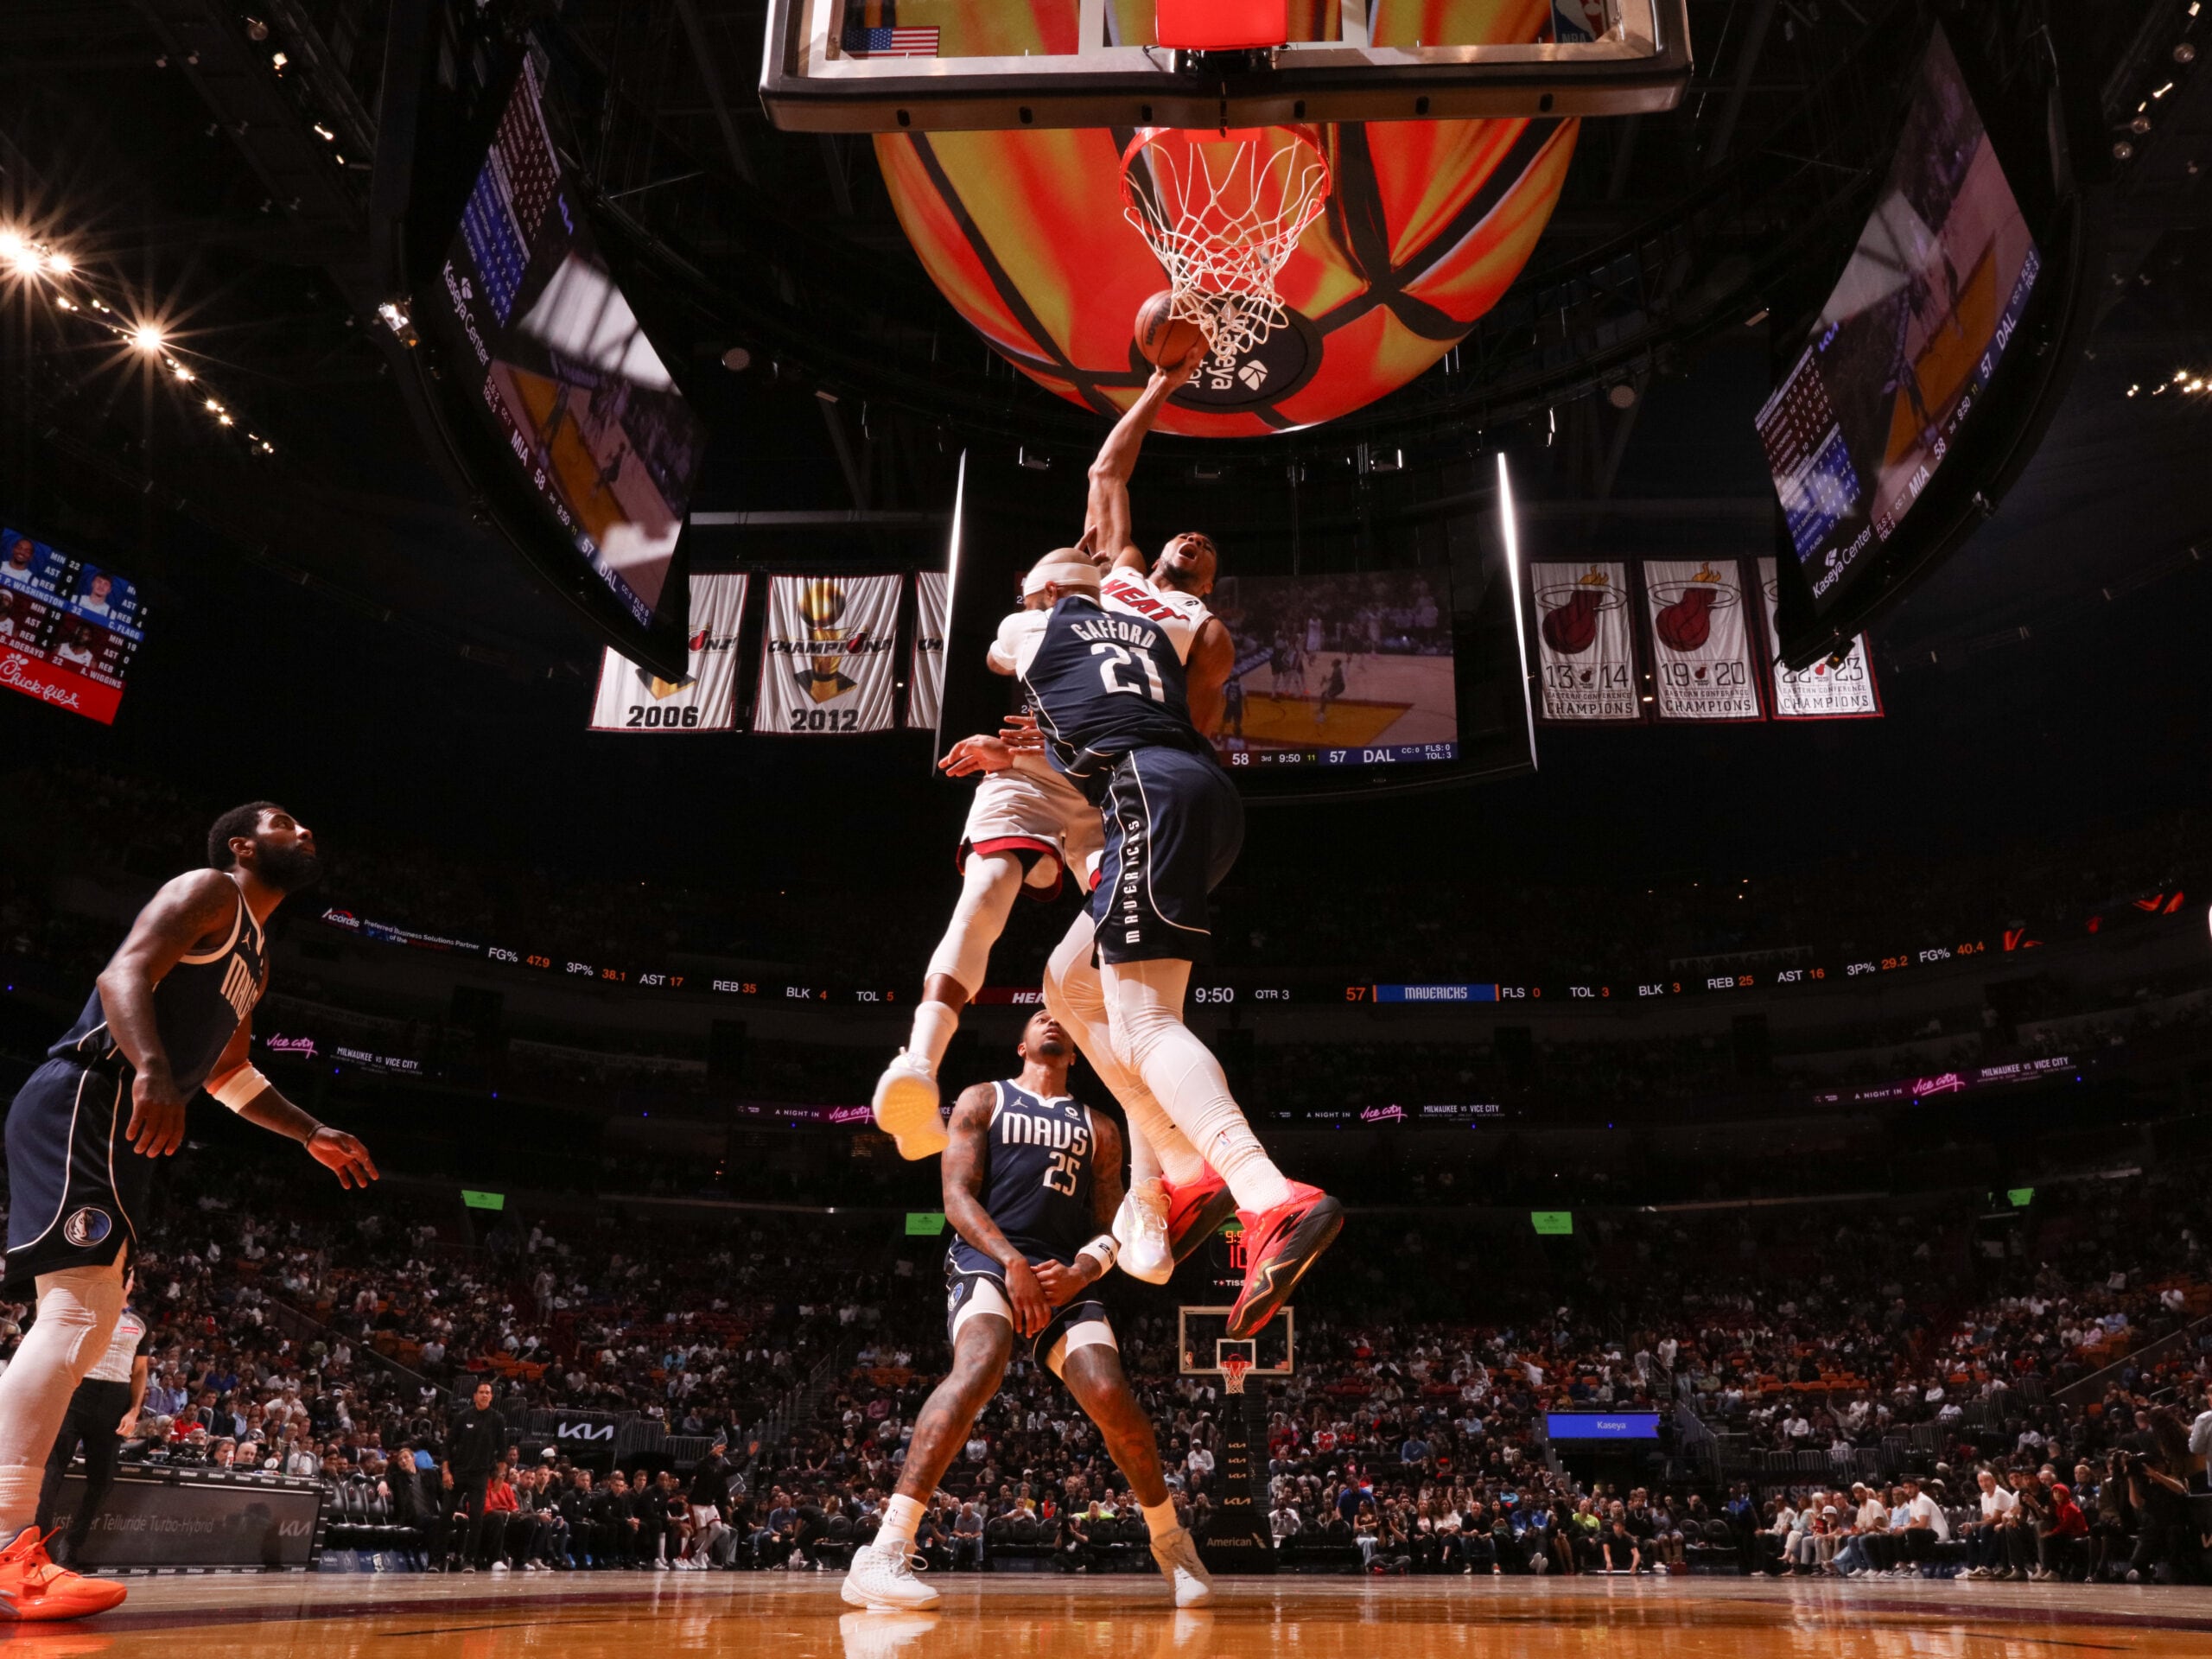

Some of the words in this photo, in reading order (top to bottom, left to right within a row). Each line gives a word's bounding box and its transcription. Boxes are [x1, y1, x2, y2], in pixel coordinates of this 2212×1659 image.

[1560, 33, 1587, 43] NBA
[443, 259, 467, 321] Kaseya
[465, 313, 489, 365] Center
[1909, 465, 1929, 498] MIA
[1934, 437, 1945, 460] 58
[1957, 396, 1971, 421] 9:50
[1980, 352, 1993, 378] 57
[1996, 313, 2017, 351] DAL
[512, 429, 528, 467] MIA
[534, 467, 545, 490] 58
[556, 504, 570, 525] 9:50
[582, 538, 594, 557] 57
[600, 561, 617, 592] DAL
[50, 552, 67, 564] MIN
[69, 560, 80, 570] 22
[1813, 561, 1844, 599] Kaseya
[1842, 524, 1872, 564] Center
[44, 566, 60, 577] AST
[13, 582, 65, 607] WASHINGTON
[40, 579, 55, 591] REB
[30, 602, 47, 614] MIN
[122, 599, 137, 611] AST
[1101, 579, 1191, 622] HEAT
[25, 617, 41, 628] AST
[47, 625, 53, 633] 3
[71, 606, 83, 616] 32
[117, 624, 140, 639] FLAGG
[116, 613, 132, 624] REB
[137, 620, 143, 629] 4
[20, 630, 36, 642] REB
[108, 634, 124, 646] MIN
[1071, 620, 1157, 648] GAFFORD
[10, 639, 44, 658] ADEBAYO
[52, 656, 64, 666] 22
[104, 648, 119, 659] AST
[99, 662, 114, 673] REB
[119, 670, 124, 678] 1
[1090, 642, 1165, 702] 21
[1546, 665, 1573, 689] 13
[1600, 664, 1629, 689] 14
[1662, 663, 1690, 687] 19
[1715, 662, 1745, 686] 20
[1835, 657, 1864, 681] 23
[90, 670, 123, 690] WIGGINS
[1783, 686, 1816, 695] EASTERN
[1819, 684, 1866, 694] CONFERENCE
[1665, 690, 1699, 698] EASTERN
[1783, 695, 1869, 709] CHAMPIONS
[1548, 702, 1633, 714] CHAMPIONS
[1666, 700, 1751, 712] CHAMPIONS
[626, 705, 699, 728] 2006
[790, 709, 859, 732] 2012
[1231, 753, 1250, 766] 58
[1261, 754, 1272, 763] 3rd
[1279, 753, 1300, 764] 9:50
[1328, 750, 1347, 764] 57
[1363, 749, 1395, 763] DAL
[1425, 744, 1444, 753] FLS:
[321, 907, 360, 928] Acordis
[364, 918, 393, 932] Preferred
[394, 926, 423, 940] Business
[423, 933, 454, 946] Solutions
[455, 939, 480, 950] Partner
[397, 935, 408, 944] the
[488, 947, 518, 963] FG%
[526, 954, 550, 968] 47.9
[566, 962, 594, 976] 3P%
[601, 968, 626, 982] 38.1
[639, 974, 665, 986] AST
[670, 976, 683, 988] 17
[713, 980, 739, 992] REB
[742, 982, 757, 994] 35
[786, 987, 810, 999] BLK
[819, 990, 827, 1001] 4
[856, 991, 880, 1001] TOL
[887, 991, 893, 1001] 5
[1345, 987, 1366, 1001] 57
[1405, 987, 1467, 1000] MAVERICKS
[1503, 988, 1525, 998] FLS
[1533, 988, 1541, 998] 0
[1570, 987, 1595, 998] TOL
[1602, 987, 1610, 997] 3
[1638, 983, 1663, 996] BLK
[1673, 982, 1681, 993] 3
[1707, 977, 1734, 989] REB
[1738, 976, 1754, 987] 25
[1777, 970, 1803, 982] AST
[1809, 969, 1825, 980] 16
[1847, 962, 1876, 976] 3P%
[1882, 955, 1909, 970] 29.2
[1919, 948, 1950, 963] FG%
[1957, 941, 1985, 957] 40.4
[1195, 987, 1234, 1002] 9:50
[1255, 989, 1278, 1000] QTR
[1282, 989, 1289, 1000] 3
[337, 1046, 373, 1062] MILWAUKEE
[385, 1057, 401, 1067] VICE
[402, 1060, 419, 1070] CITY
[1864, 1090, 1891, 1098] NIGHT
[1981, 1064, 2020, 1077] MILWAUKEE
[2034, 1058, 2050, 1069] VICE
[2052, 1057, 2069, 1067] CITY
[1002, 1112, 1088, 1156] MAVS
[1043, 1151, 1080, 1197] 25
[557, 1421, 614, 1440] KIA
[1597, 1421, 1626, 1431] Kaseya
[1758, 1485, 1786, 1501] HOT
[102, 1513, 146, 1532] Telluride
[149, 1514, 213, 1535] Turbo-Hybrid
[279, 1520, 312, 1536] KIA
[1206, 1536, 1252, 1547] American
